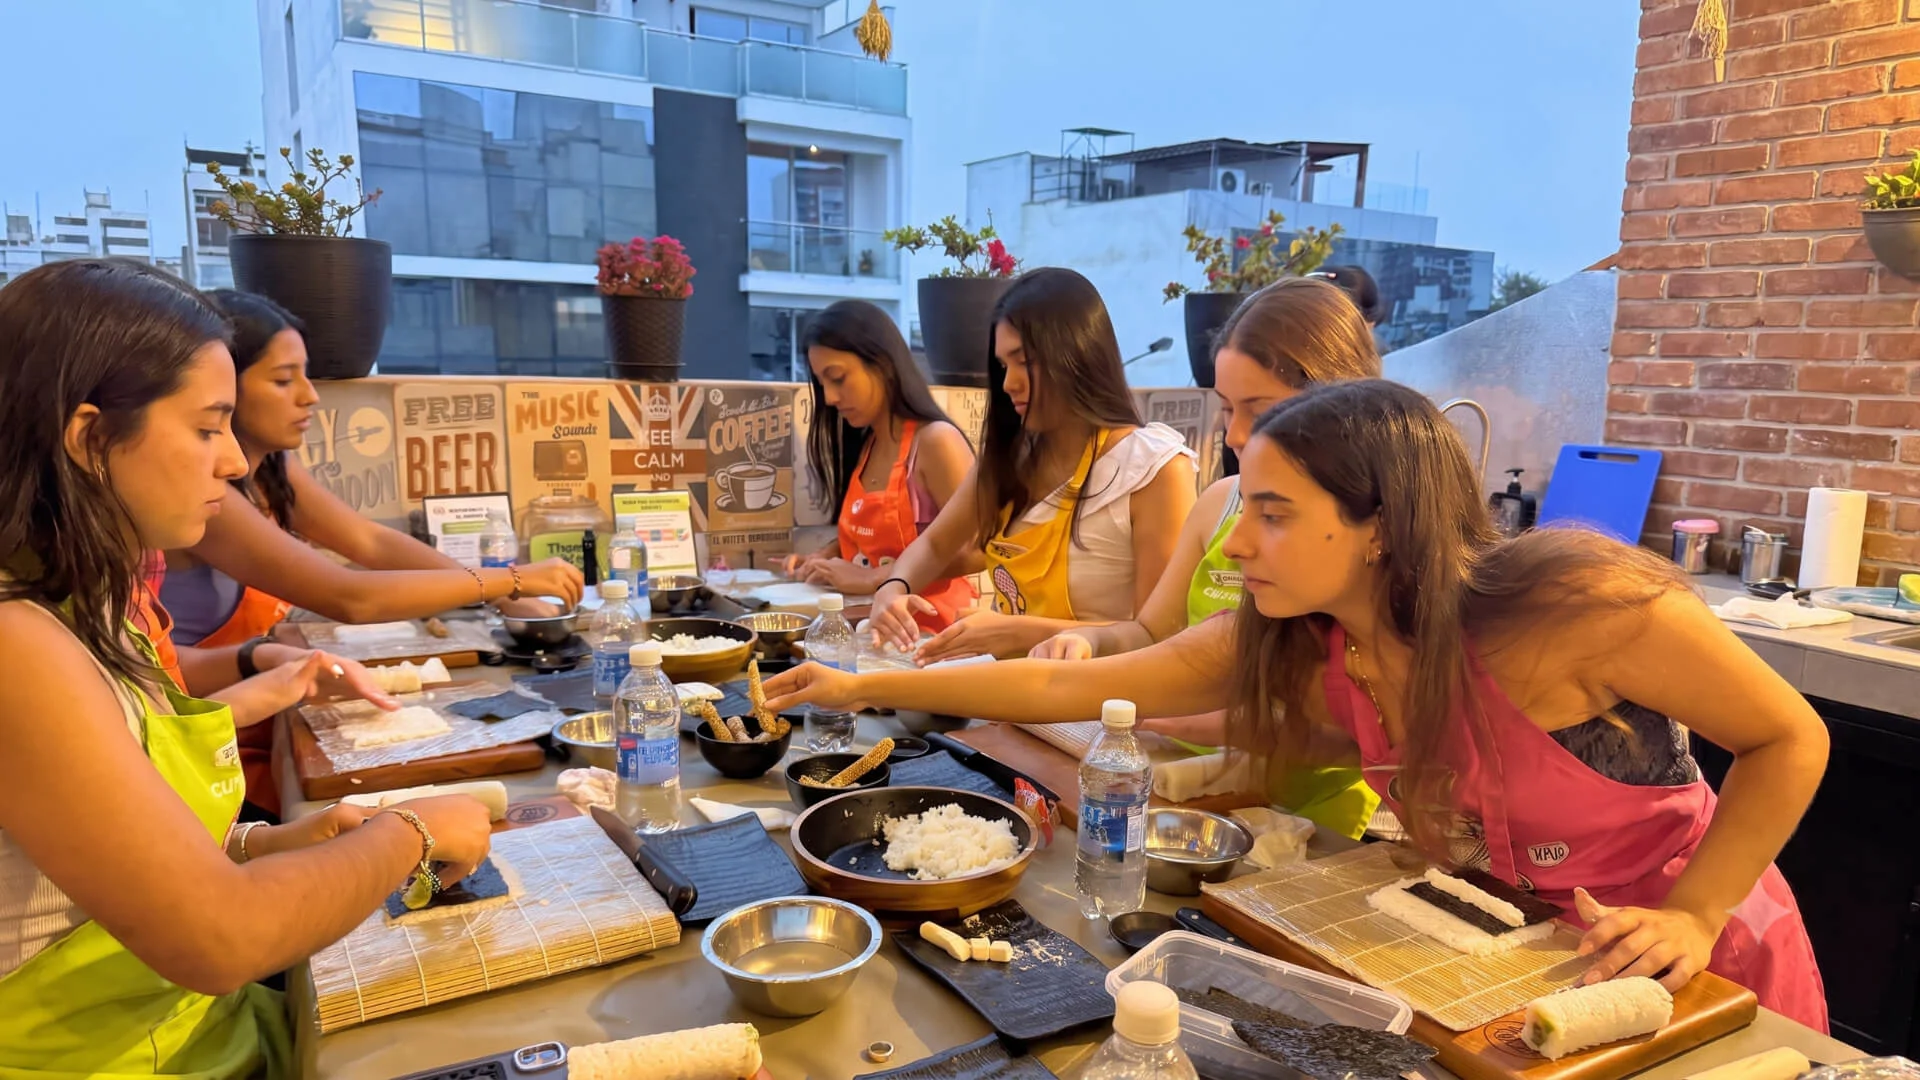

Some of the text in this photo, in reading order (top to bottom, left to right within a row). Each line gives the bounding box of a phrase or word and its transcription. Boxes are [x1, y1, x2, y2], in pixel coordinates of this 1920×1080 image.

[521, 391, 539, 399] THE
[403, 393, 496, 426] FREE
[515, 389, 600, 434] MUSIC
[1152, 399, 1202, 421] FREE
[552, 423, 599, 440] Sounds
[709, 405, 791, 455] COFFEE
[405, 432, 498, 501] BEER
[633, 452, 685, 469] CALM
[649, 473, 671, 483] AND
